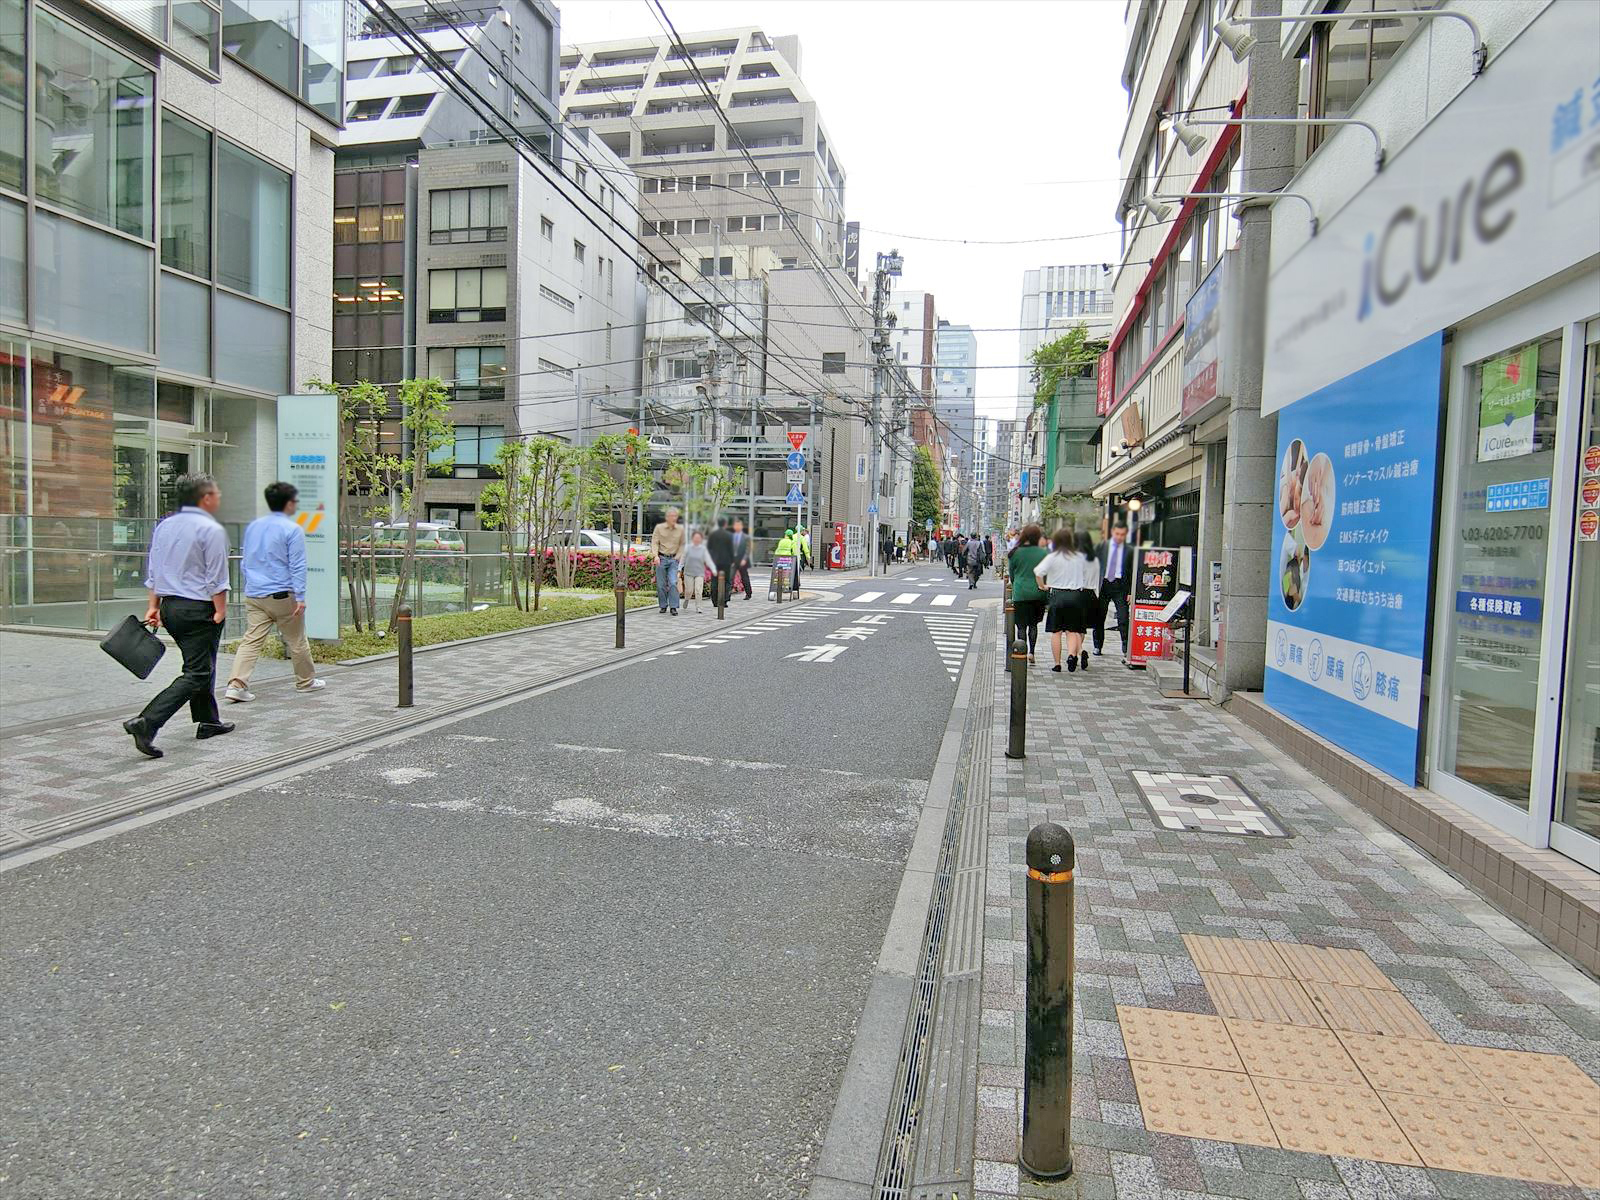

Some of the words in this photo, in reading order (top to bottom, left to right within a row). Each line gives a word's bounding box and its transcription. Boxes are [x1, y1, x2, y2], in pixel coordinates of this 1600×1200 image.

[847, 232, 858, 278] 虎ノ門
[1357, 148, 1525, 322] iCure
[1143, 641, 1160, 652] 2F
[1325, 655, 1345, 681] 腰痛
[1375, 671, 1400, 702] 膝痛
